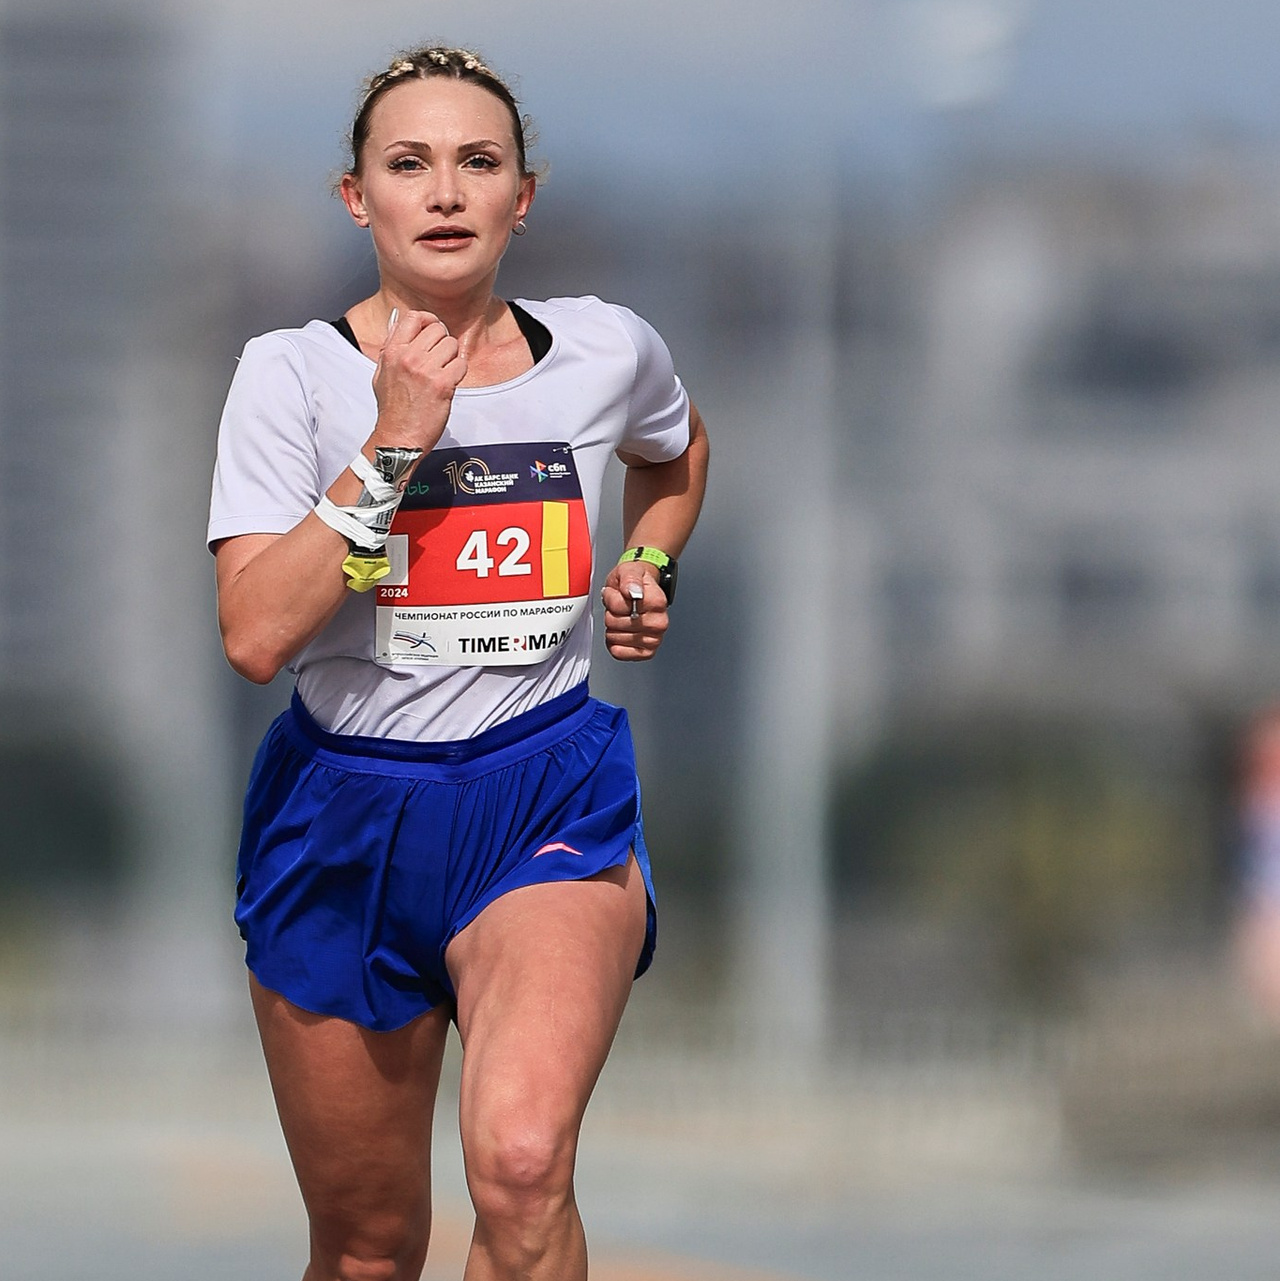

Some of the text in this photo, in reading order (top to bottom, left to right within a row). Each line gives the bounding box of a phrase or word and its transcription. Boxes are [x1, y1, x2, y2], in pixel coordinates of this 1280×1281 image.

[456, 527, 532, 577] 42
[380, 587, 409, 598] 2024
[395, 604, 574, 621] ЧЕМПИОНАТ РОССИИ ПО МАРАФОНУ
